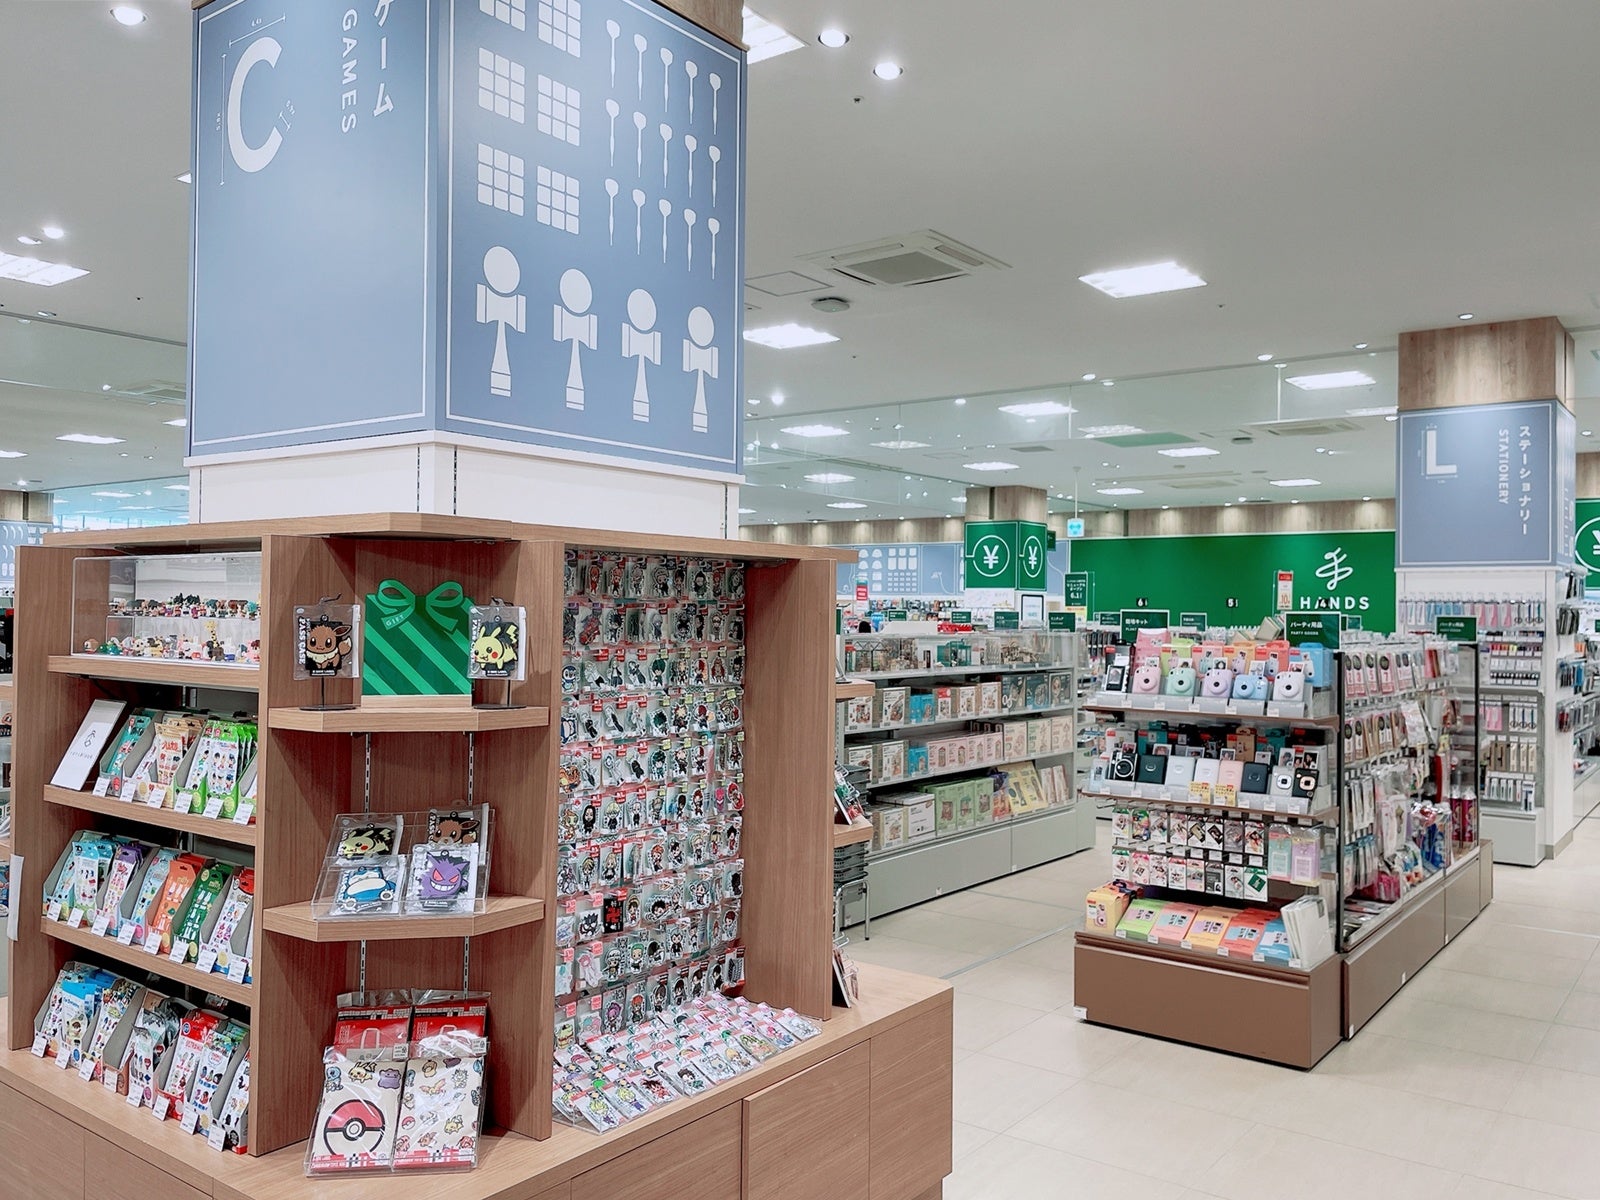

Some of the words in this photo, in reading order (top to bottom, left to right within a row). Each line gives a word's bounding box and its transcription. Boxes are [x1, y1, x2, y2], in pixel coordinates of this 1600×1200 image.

[341, 8, 358, 133] GAMES
[227, 36, 283, 173] C
[1426, 430, 1457, 475] L
[1498, 428, 1509, 505] STATIONERY
[1518, 425, 1531, 535] ステーショナリー
[1137, 598, 1144, 607] 6
[298, 617, 307, 641] PASS
[385, 614, 404, 627] GIFT
[1290, 621, 1323, 629] パーティ用品
[298, 641, 307, 665] CASE
